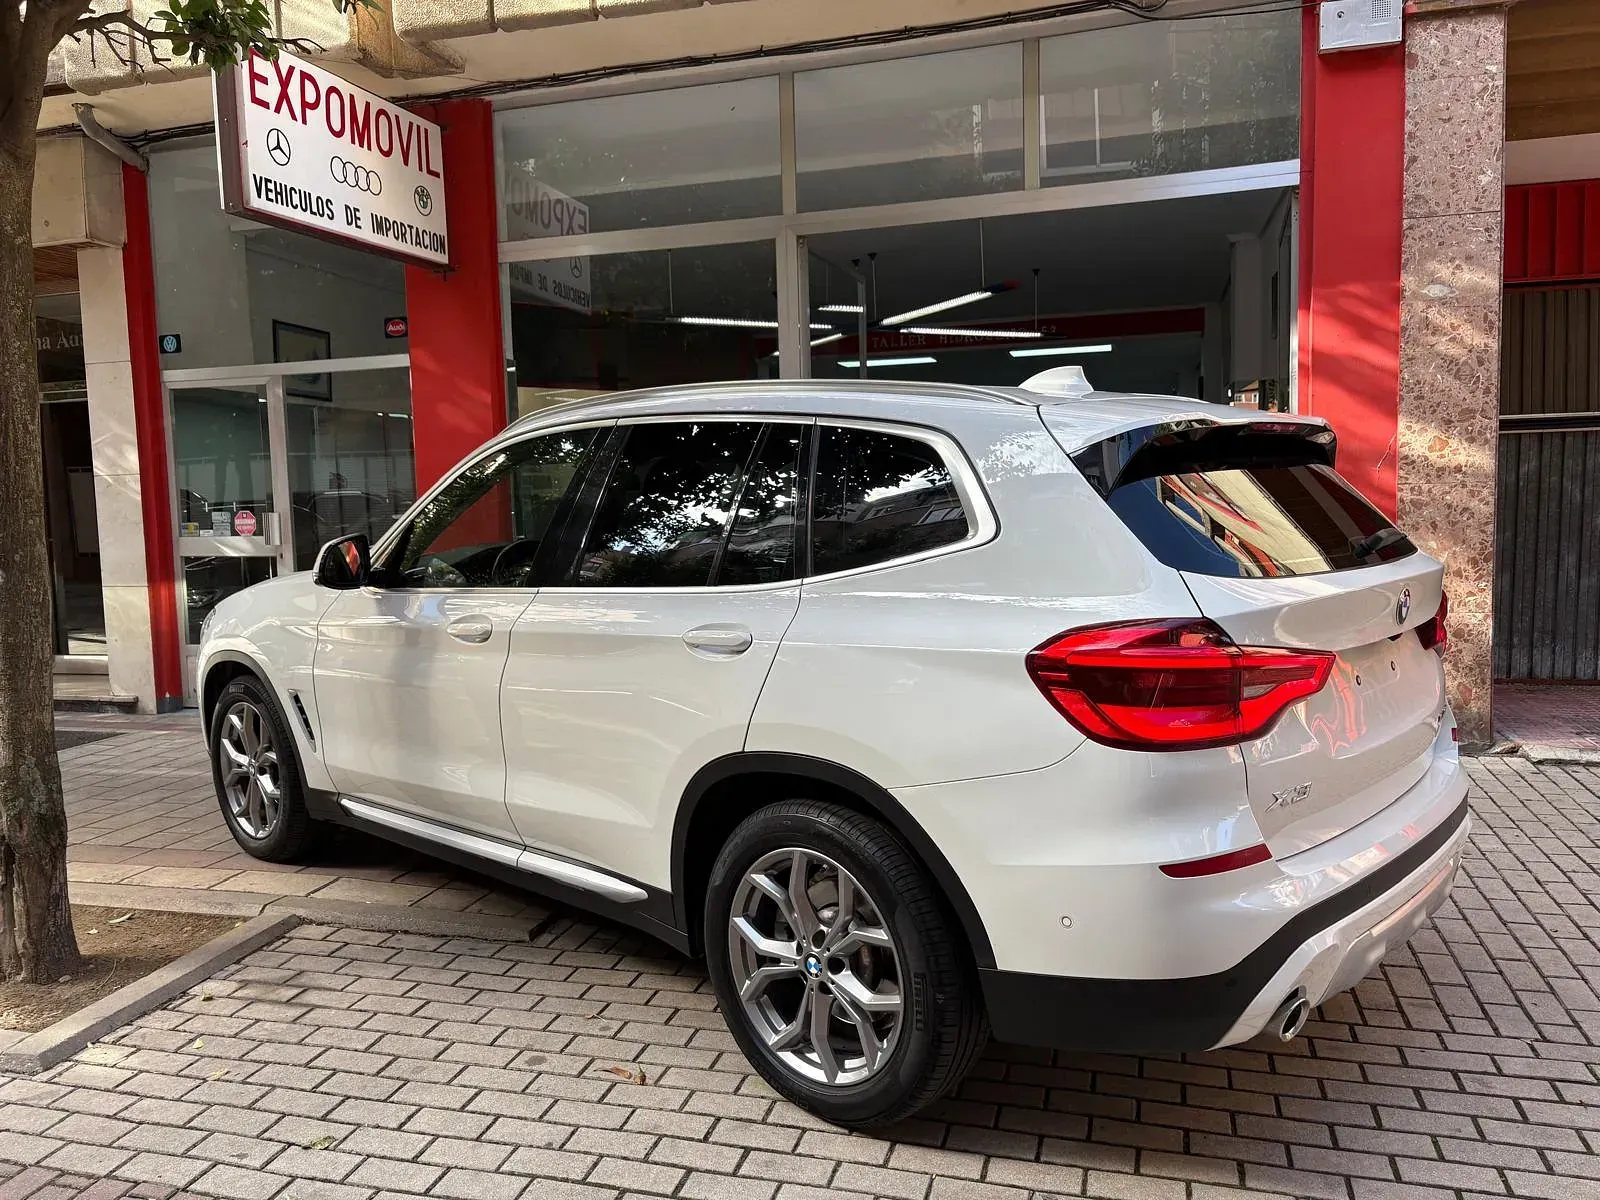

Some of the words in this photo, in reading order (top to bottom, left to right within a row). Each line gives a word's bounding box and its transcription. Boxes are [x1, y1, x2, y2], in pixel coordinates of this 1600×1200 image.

[248, 47, 441, 179] EXPOMOVIL
[252, 173, 335, 221] VEHICULOS
[344, 203, 362, 229] DE
[370, 212, 446, 255] IMPORTACION
[873, 334, 927, 349] TALLER
[1265, 781, 1312, 813] X3
